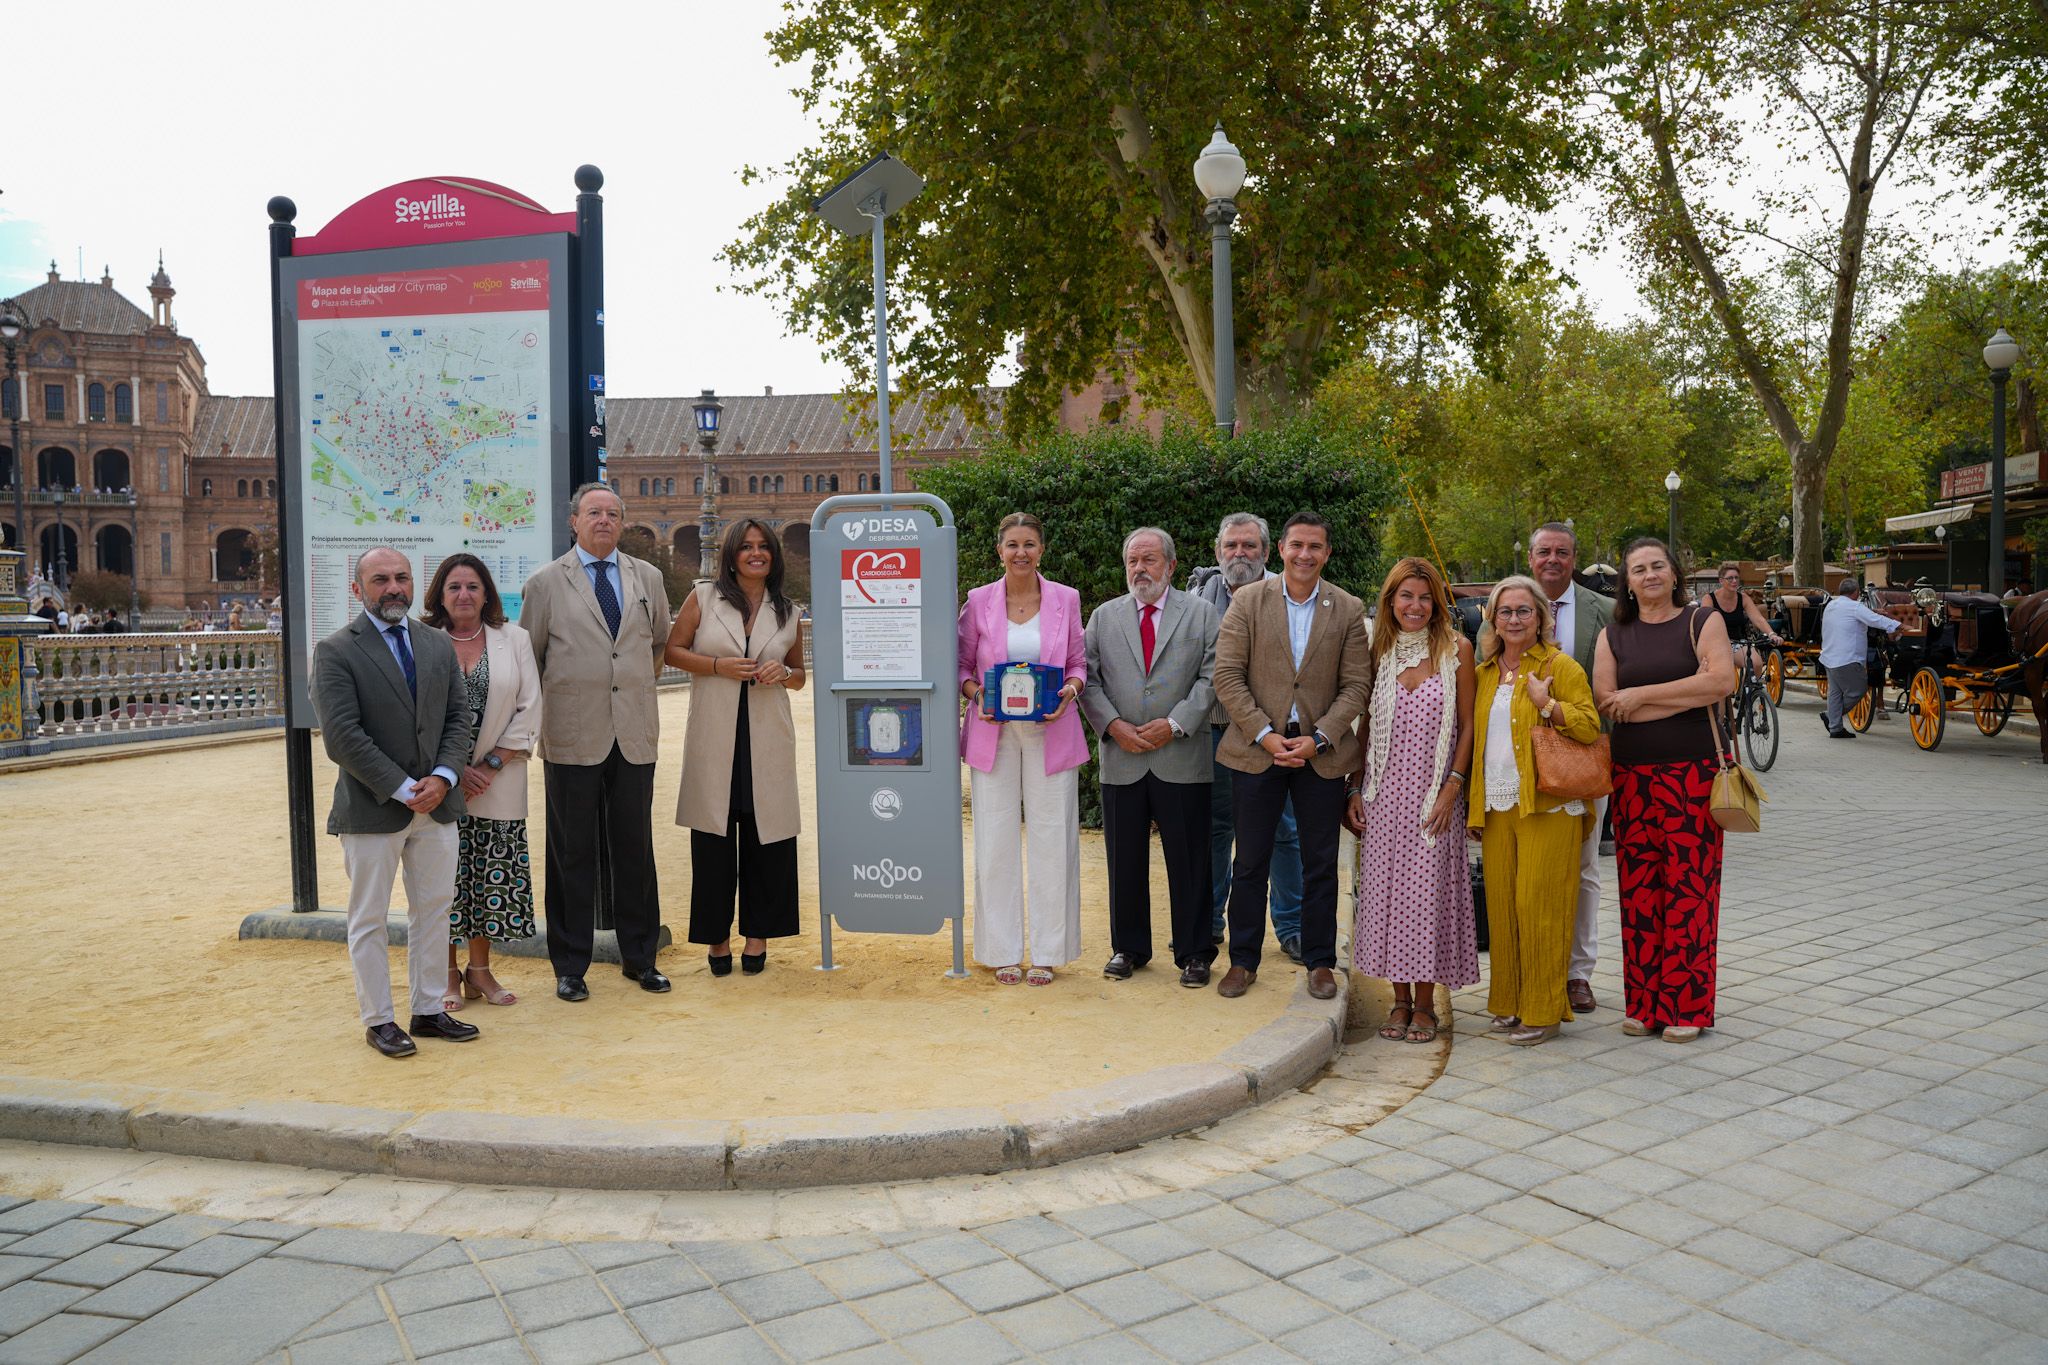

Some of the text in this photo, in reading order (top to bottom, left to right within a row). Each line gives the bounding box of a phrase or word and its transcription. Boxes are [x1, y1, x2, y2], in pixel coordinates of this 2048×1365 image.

[312, 285, 338, 297] Mapa
[340, 285, 352, 295] de
[353, 284, 362, 294] la
[363, 282, 396, 294] ciudad
[405, 281, 425, 293] City
[426, 281, 448, 293] map
[321, 299, 339, 307] Plaza
[350, 298, 375, 307] España
[1958, 466, 1985, 477] VENTA
[1949, 484, 1980, 496] TCKETS
[869, 518, 918, 533] DESA
[311, 535, 342, 543] Principales
[384, 535, 405, 543] lugares
[869, 534, 919, 542] DESFIBRILADOR
